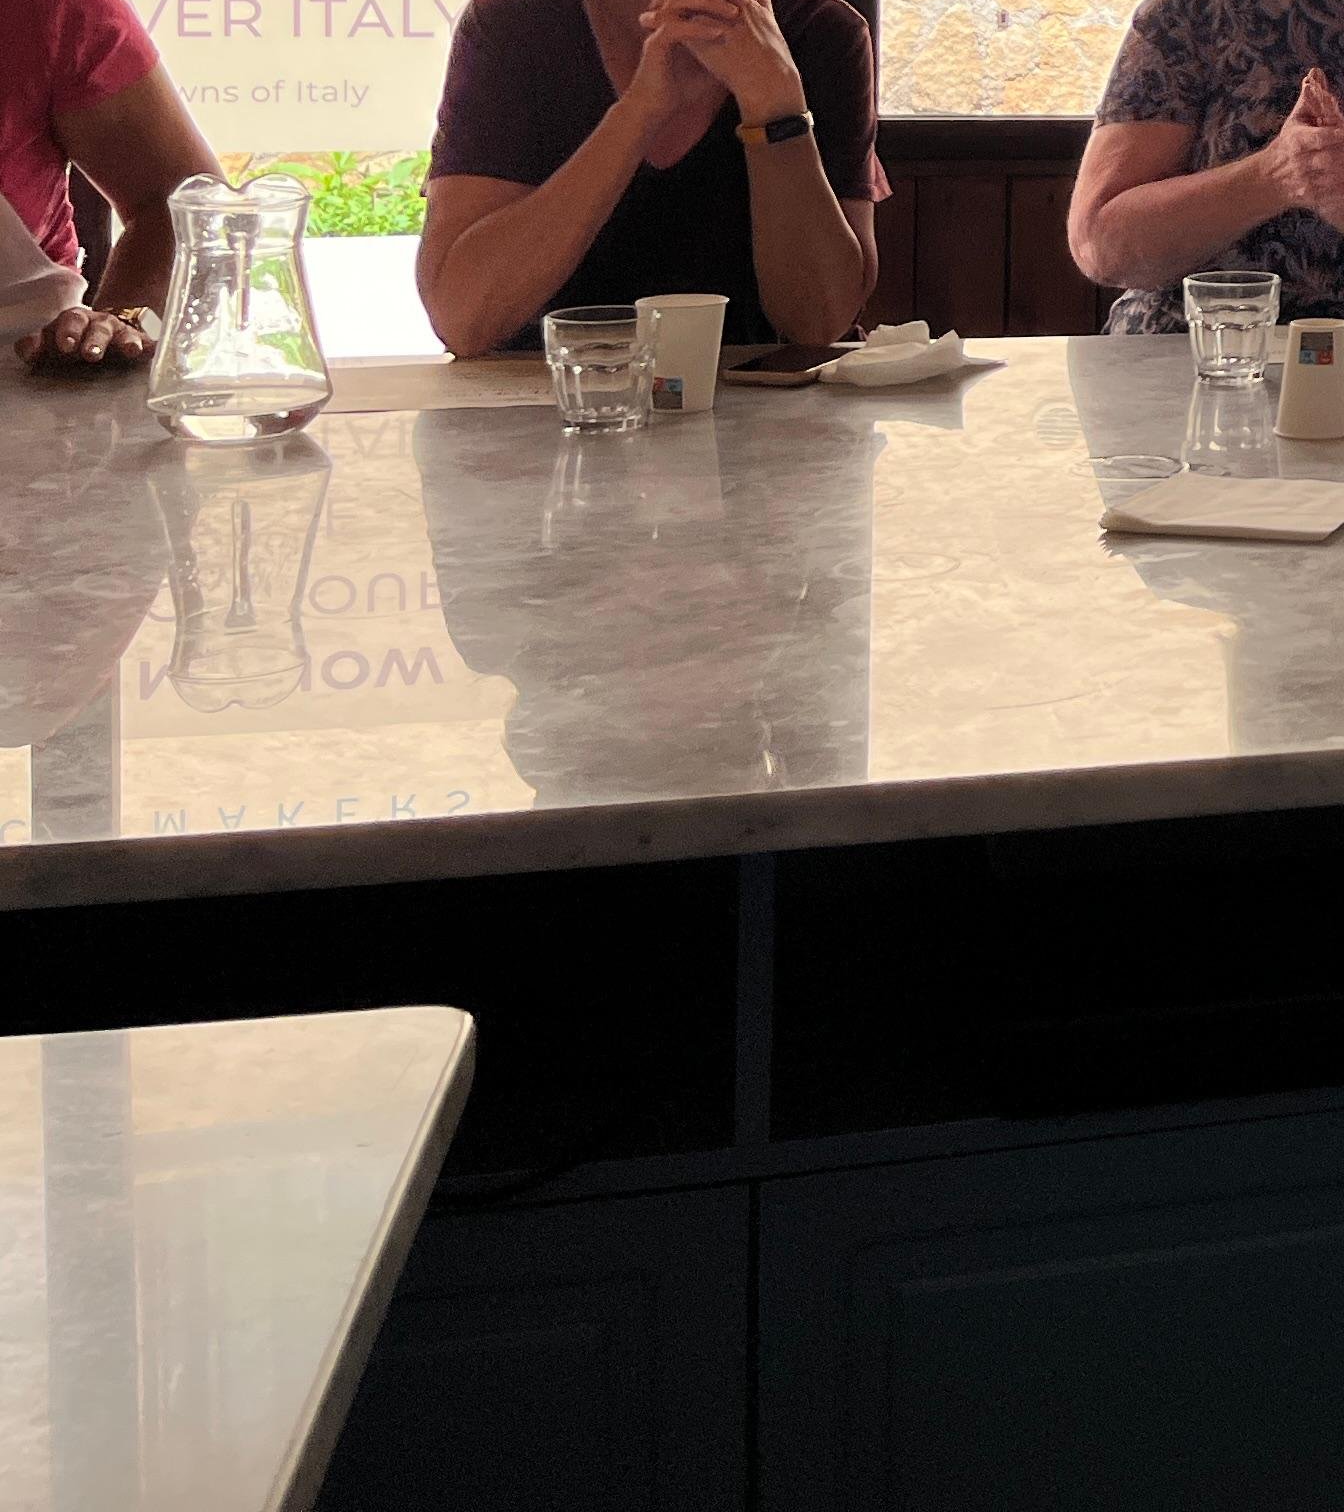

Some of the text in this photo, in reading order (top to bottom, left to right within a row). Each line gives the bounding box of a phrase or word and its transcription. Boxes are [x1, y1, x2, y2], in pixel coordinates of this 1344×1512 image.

[178, 79, 370, 109] wns of Italy
